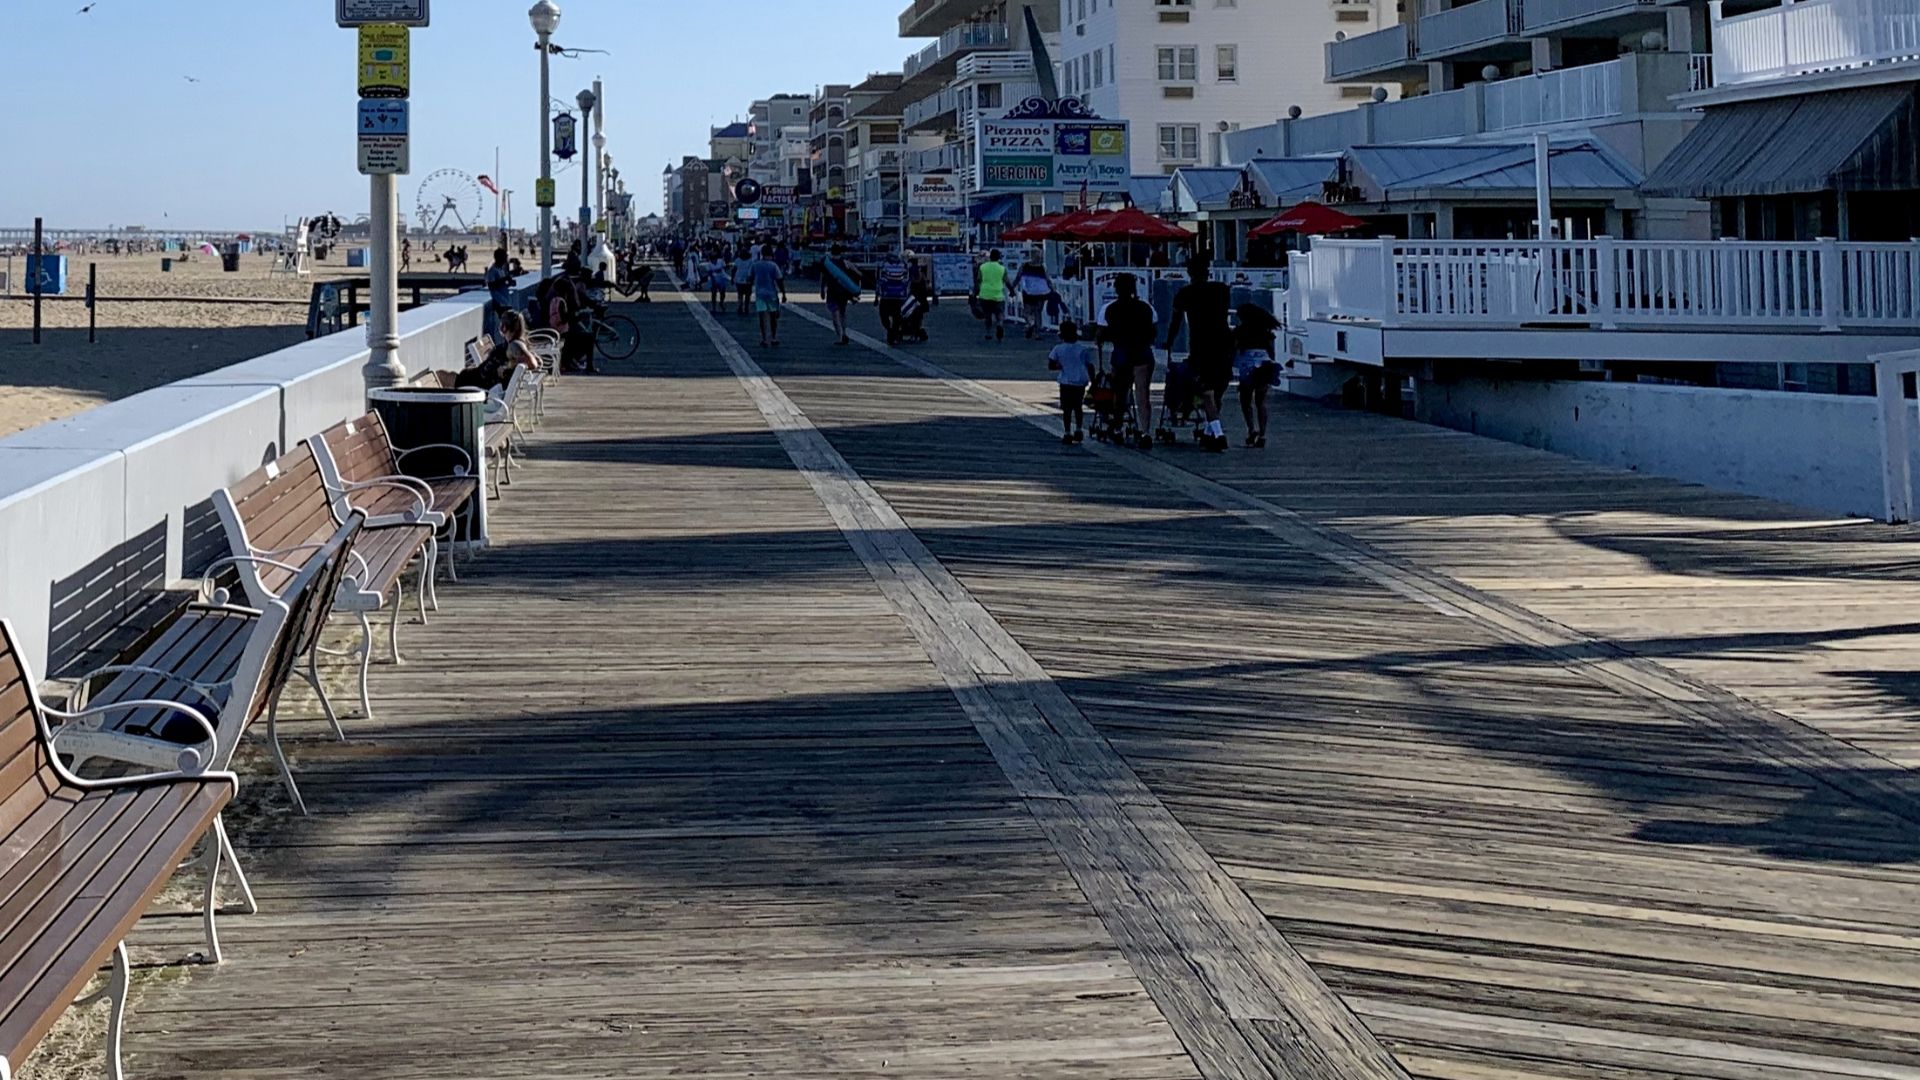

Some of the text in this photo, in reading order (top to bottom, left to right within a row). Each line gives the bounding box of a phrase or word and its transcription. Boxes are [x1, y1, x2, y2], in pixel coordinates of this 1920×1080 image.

[984, 123, 1050, 136] Piezano's
[990, 137, 1044, 147] PIZZA
[987, 165, 1047, 180] PIERCING
[913, 184, 955, 193] Boardwalk
[762, 195, 797, 203] FACTORY
